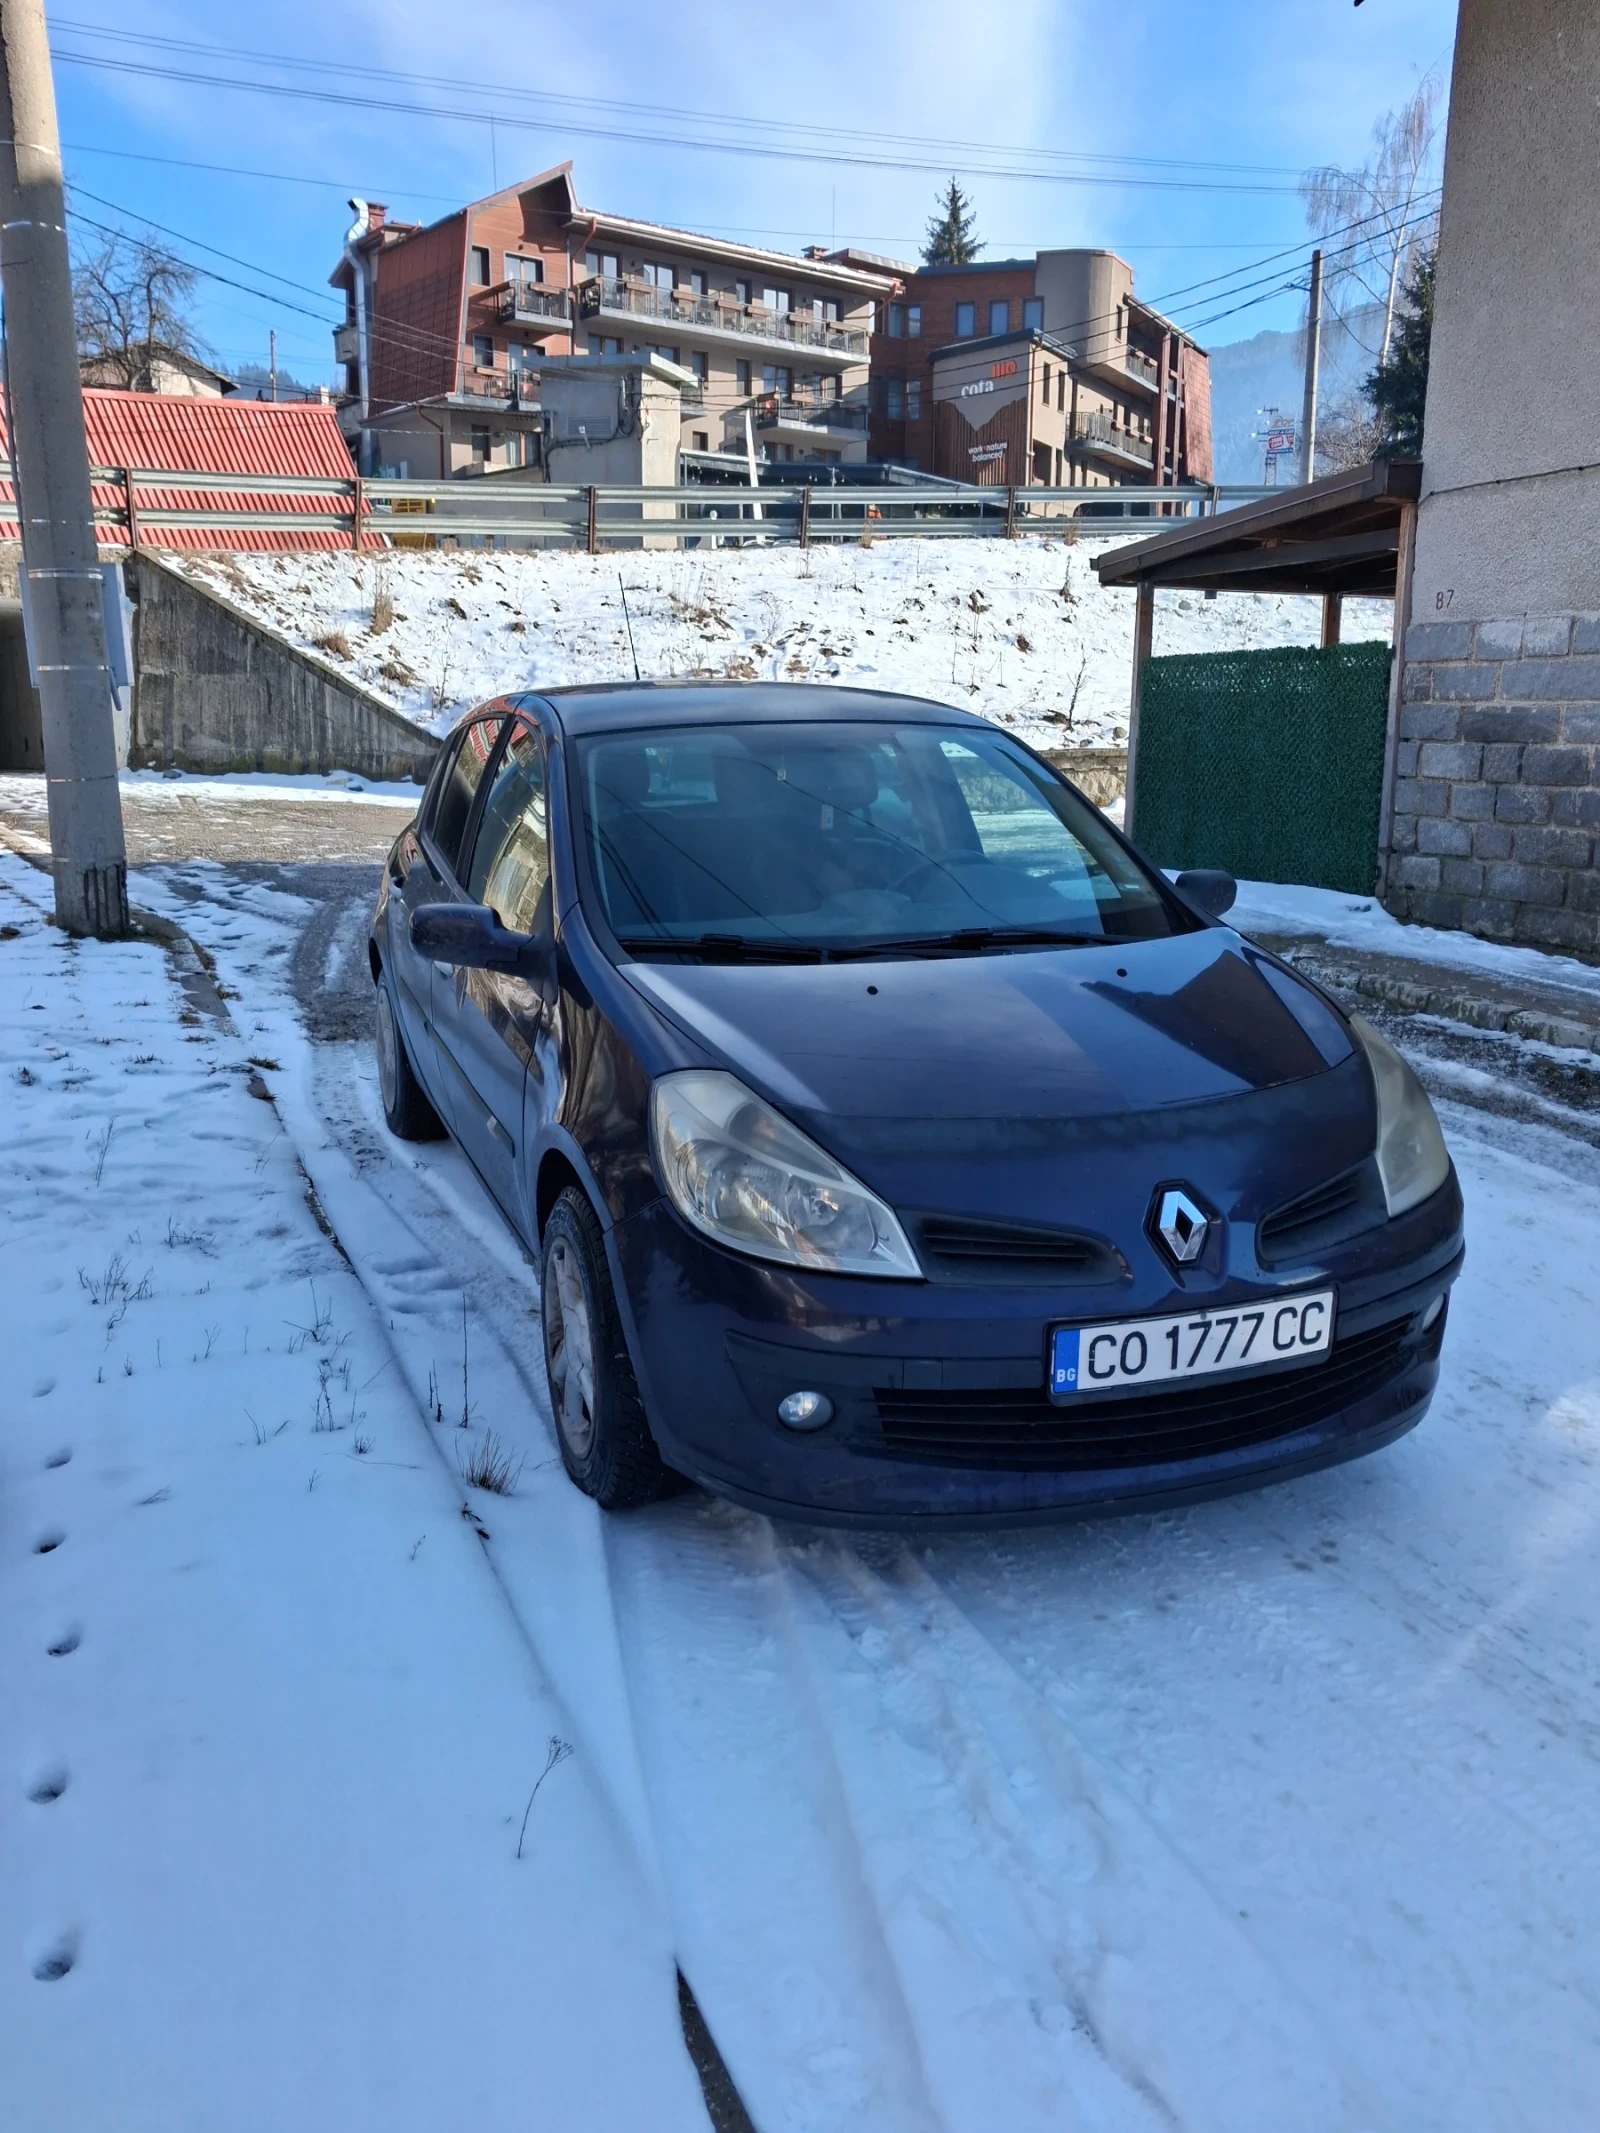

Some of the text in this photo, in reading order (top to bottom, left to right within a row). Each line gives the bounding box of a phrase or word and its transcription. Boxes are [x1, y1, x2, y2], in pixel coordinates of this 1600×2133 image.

[968, 442, 1008, 454] work nature
[972, 450, 1003, 462] balanced
[1436, 589, 1455, 610] 87
[1088, 1301, 1324, 1379] CO 1777 CC
[1056, 1367, 1076, 1383] BG
